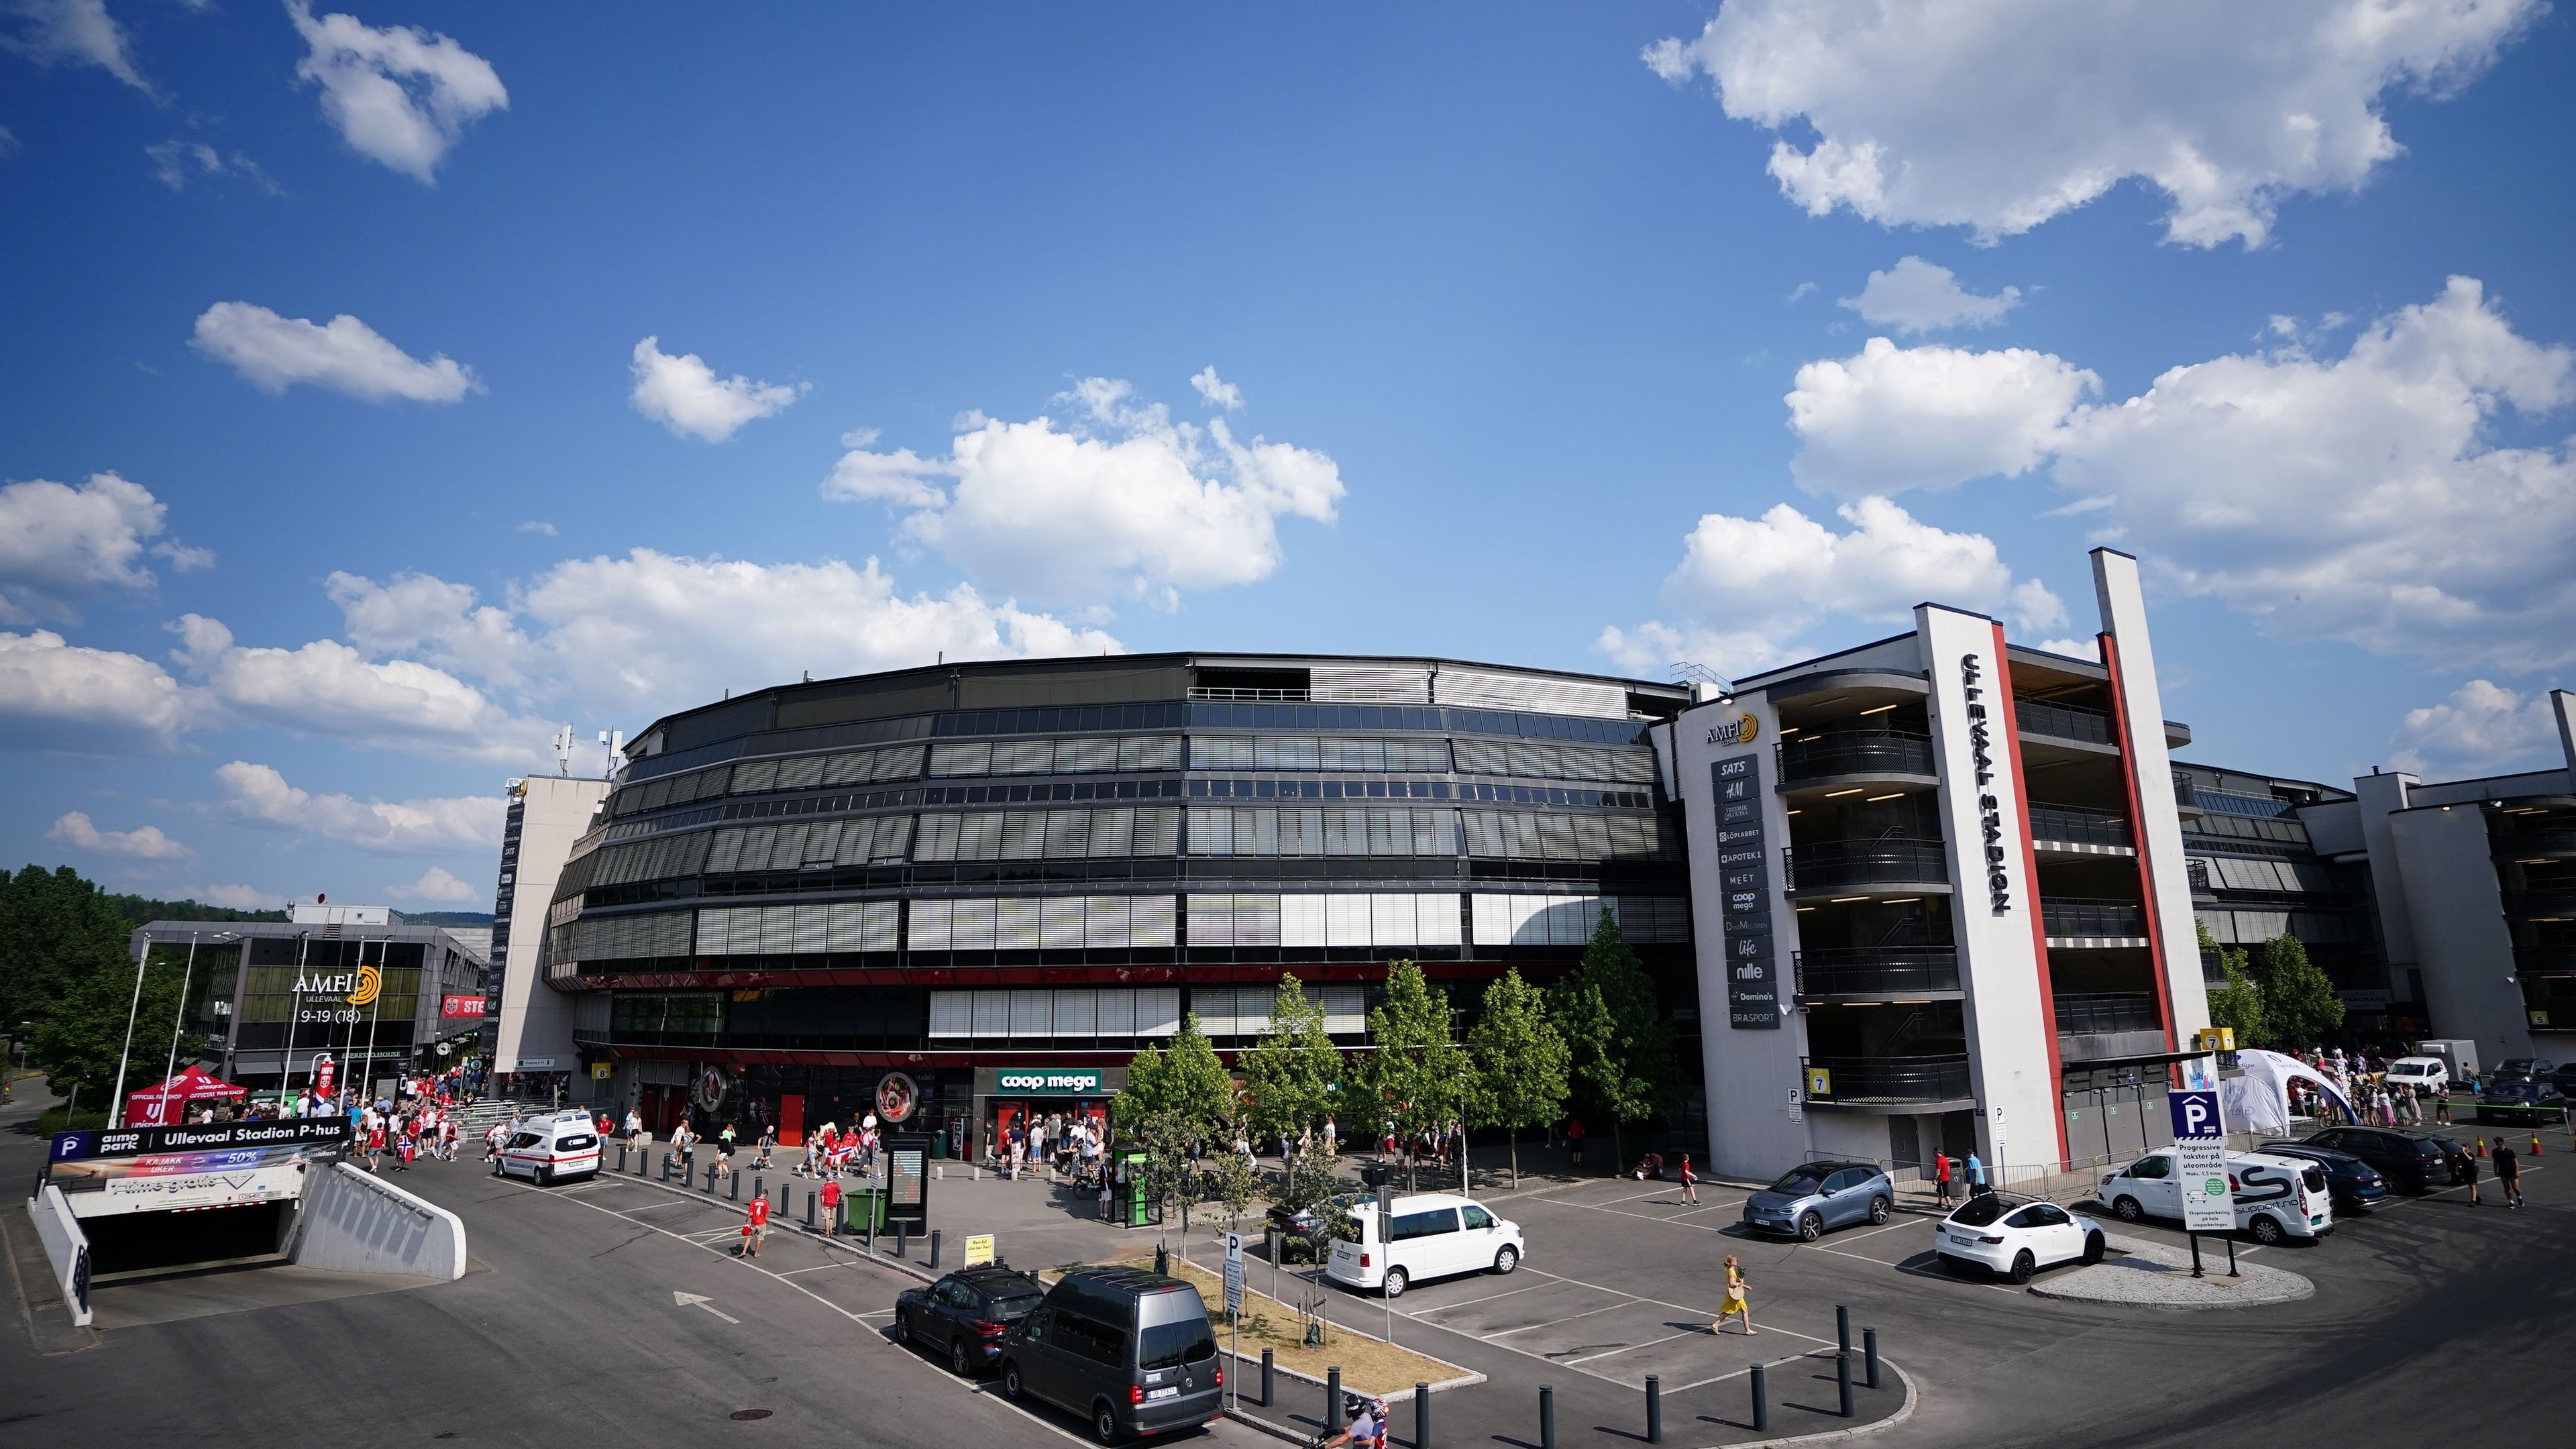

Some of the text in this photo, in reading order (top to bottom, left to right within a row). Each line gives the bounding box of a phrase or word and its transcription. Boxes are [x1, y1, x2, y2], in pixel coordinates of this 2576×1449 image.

[1706, 719, 1740, 743] AMFI
[1721, 761, 1746, 776] SATS
[1964, 653, 2011, 910] ULLEVAAL STADION
[1725, 781, 1743, 799] H&M
[1725, 805, 1748, 814] FREDRIK
[504, 847, 515, 856] SATS
[1728, 851, 1762, 862] APOTEK 1
[1729, 874, 1754, 885] MEET
[1732, 893, 1756, 902] coop
[1733, 902, 1754, 911] mega
[1739, 939, 1758, 957] life
[1736, 963, 1764, 979] nille
[292, 973, 354, 994] AMFI
[306, 996, 342, 1004] ULLEVAAL
[1740, 991, 1774, 1001] Domino's
[301, 1010, 361, 1024] 9-19 (18)
[2208, 1039, 2217, 1049] 7
[2226, 1038, 2231, 1049] 7
[321, 1067, 334, 1075] INFO
[1002, 1076, 1096, 1091] coop mega
[1816, 1079, 1823, 1090] 7
[1790, 1090, 1798, 1102] P
[1996, 1108, 2002, 1122] P
[2185, 1104, 2207, 1134] P
[101, 1133, 140, 1143] aimo
[164, 1124, 341, 1145] Ullevaal Stadion P-hus
[377, 1132, 382, 1140] 9
[61, 1141, 77, 1156] P
[101, 1140, 138, 1153] park
[2179, 1144, 2220, 1152] Progressive
[145, 1157, 183, 1166] KAJAKK
[227, 1151, 258, 1164] 50%
[2210, 1152, 2220, 1161] på
[150, 1165, 176, 1173] UKER
[125, 1180, 163, 1194] time
[168, 1174, 216, 1193] gratis
[1230, 1236, 1238, 1256] P
